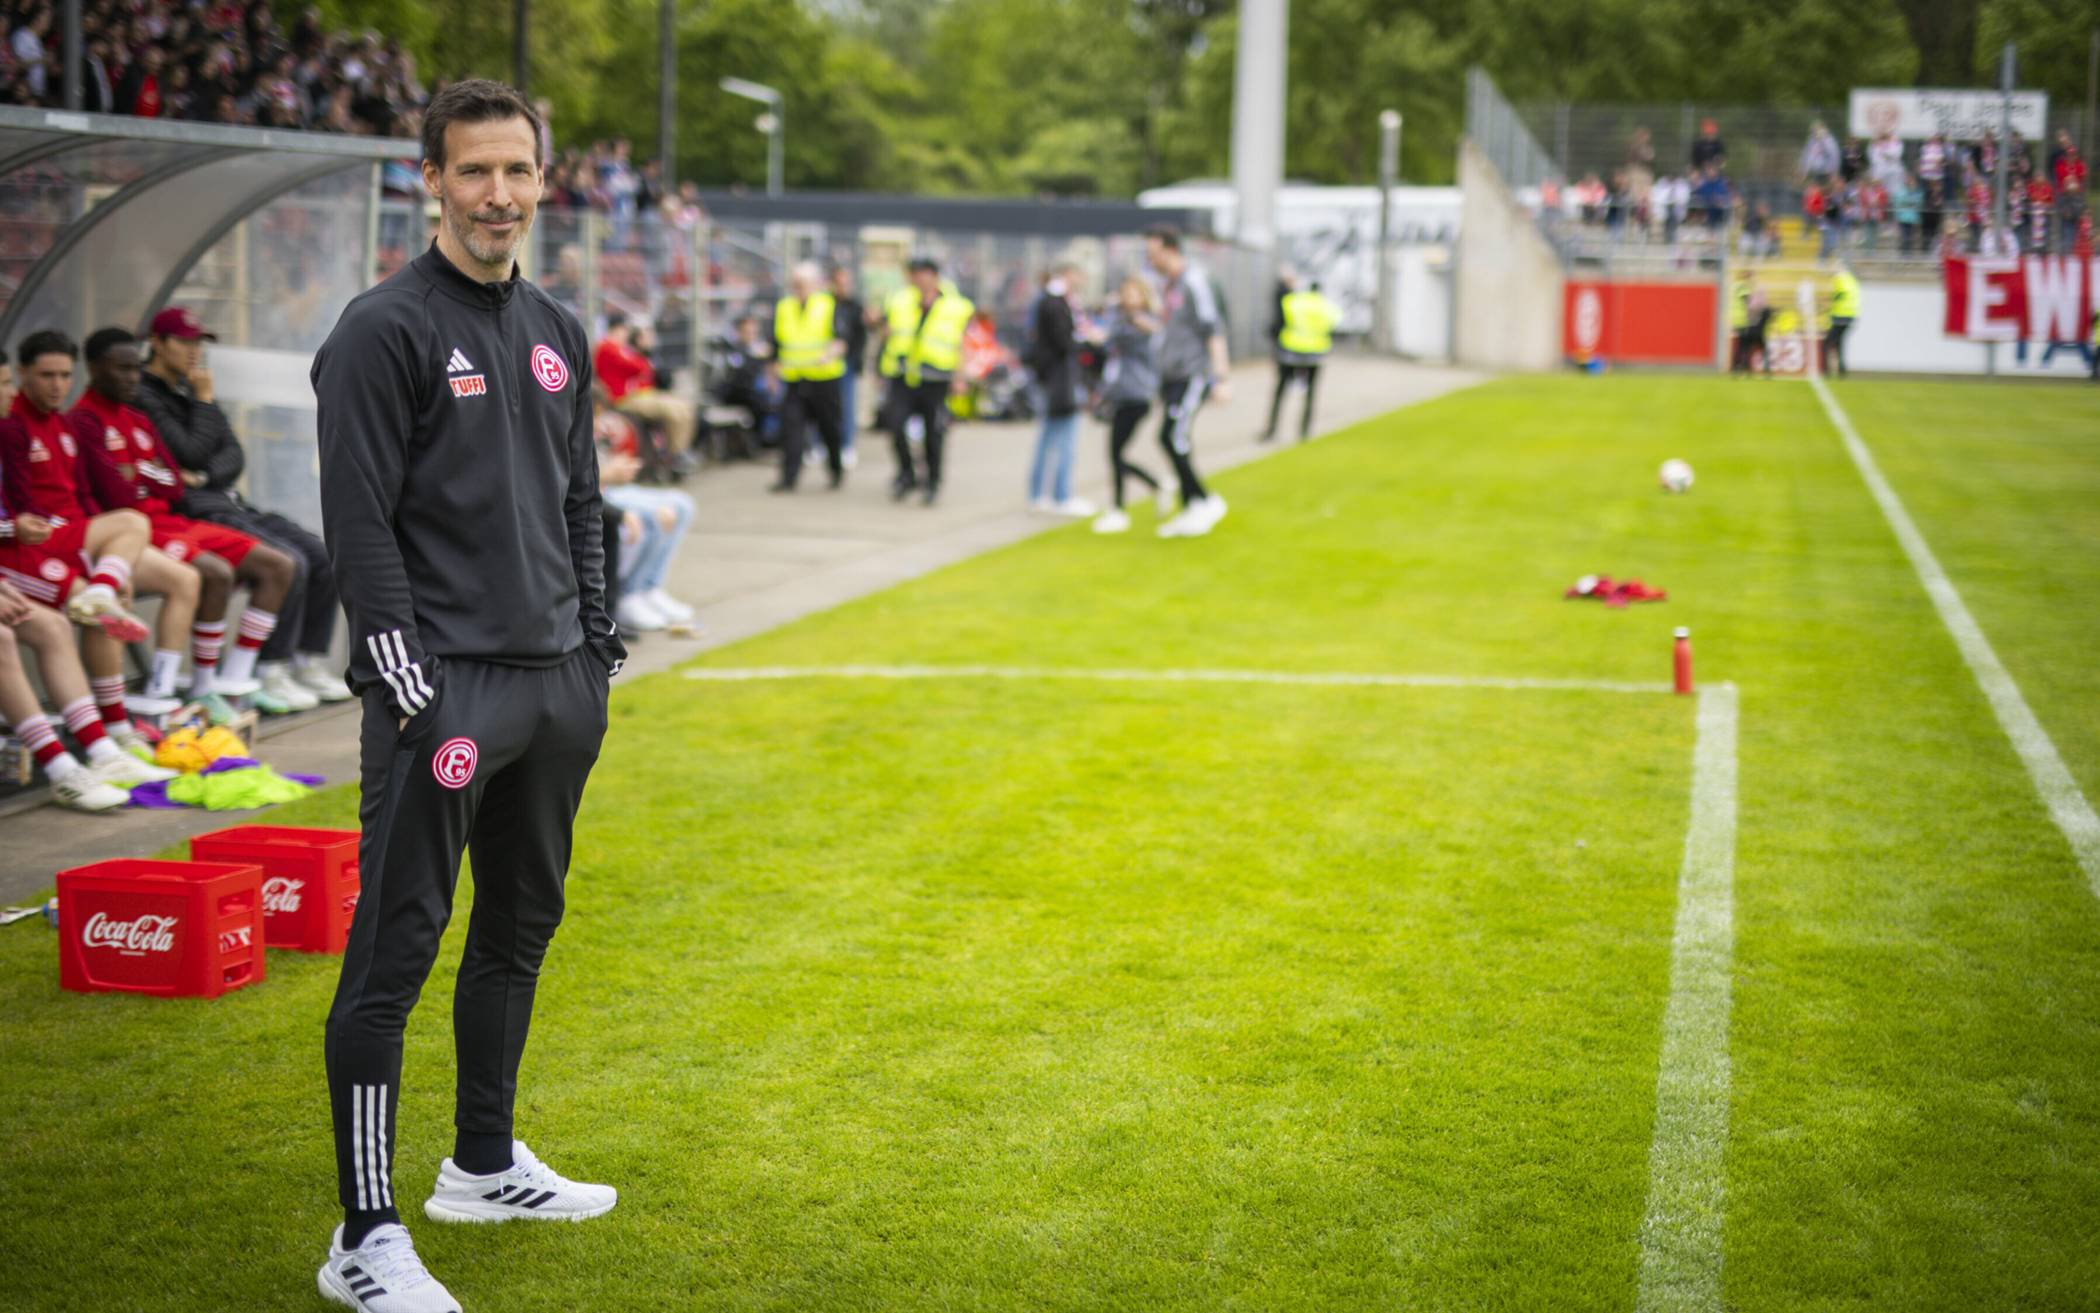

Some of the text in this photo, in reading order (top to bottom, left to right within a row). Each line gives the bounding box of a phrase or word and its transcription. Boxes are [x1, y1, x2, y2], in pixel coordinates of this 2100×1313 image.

[448, 374, 487, 397] TUFFI
[261, 877, 305, 913] Cola
[83, 912, 178, 952] Coca-Cola
